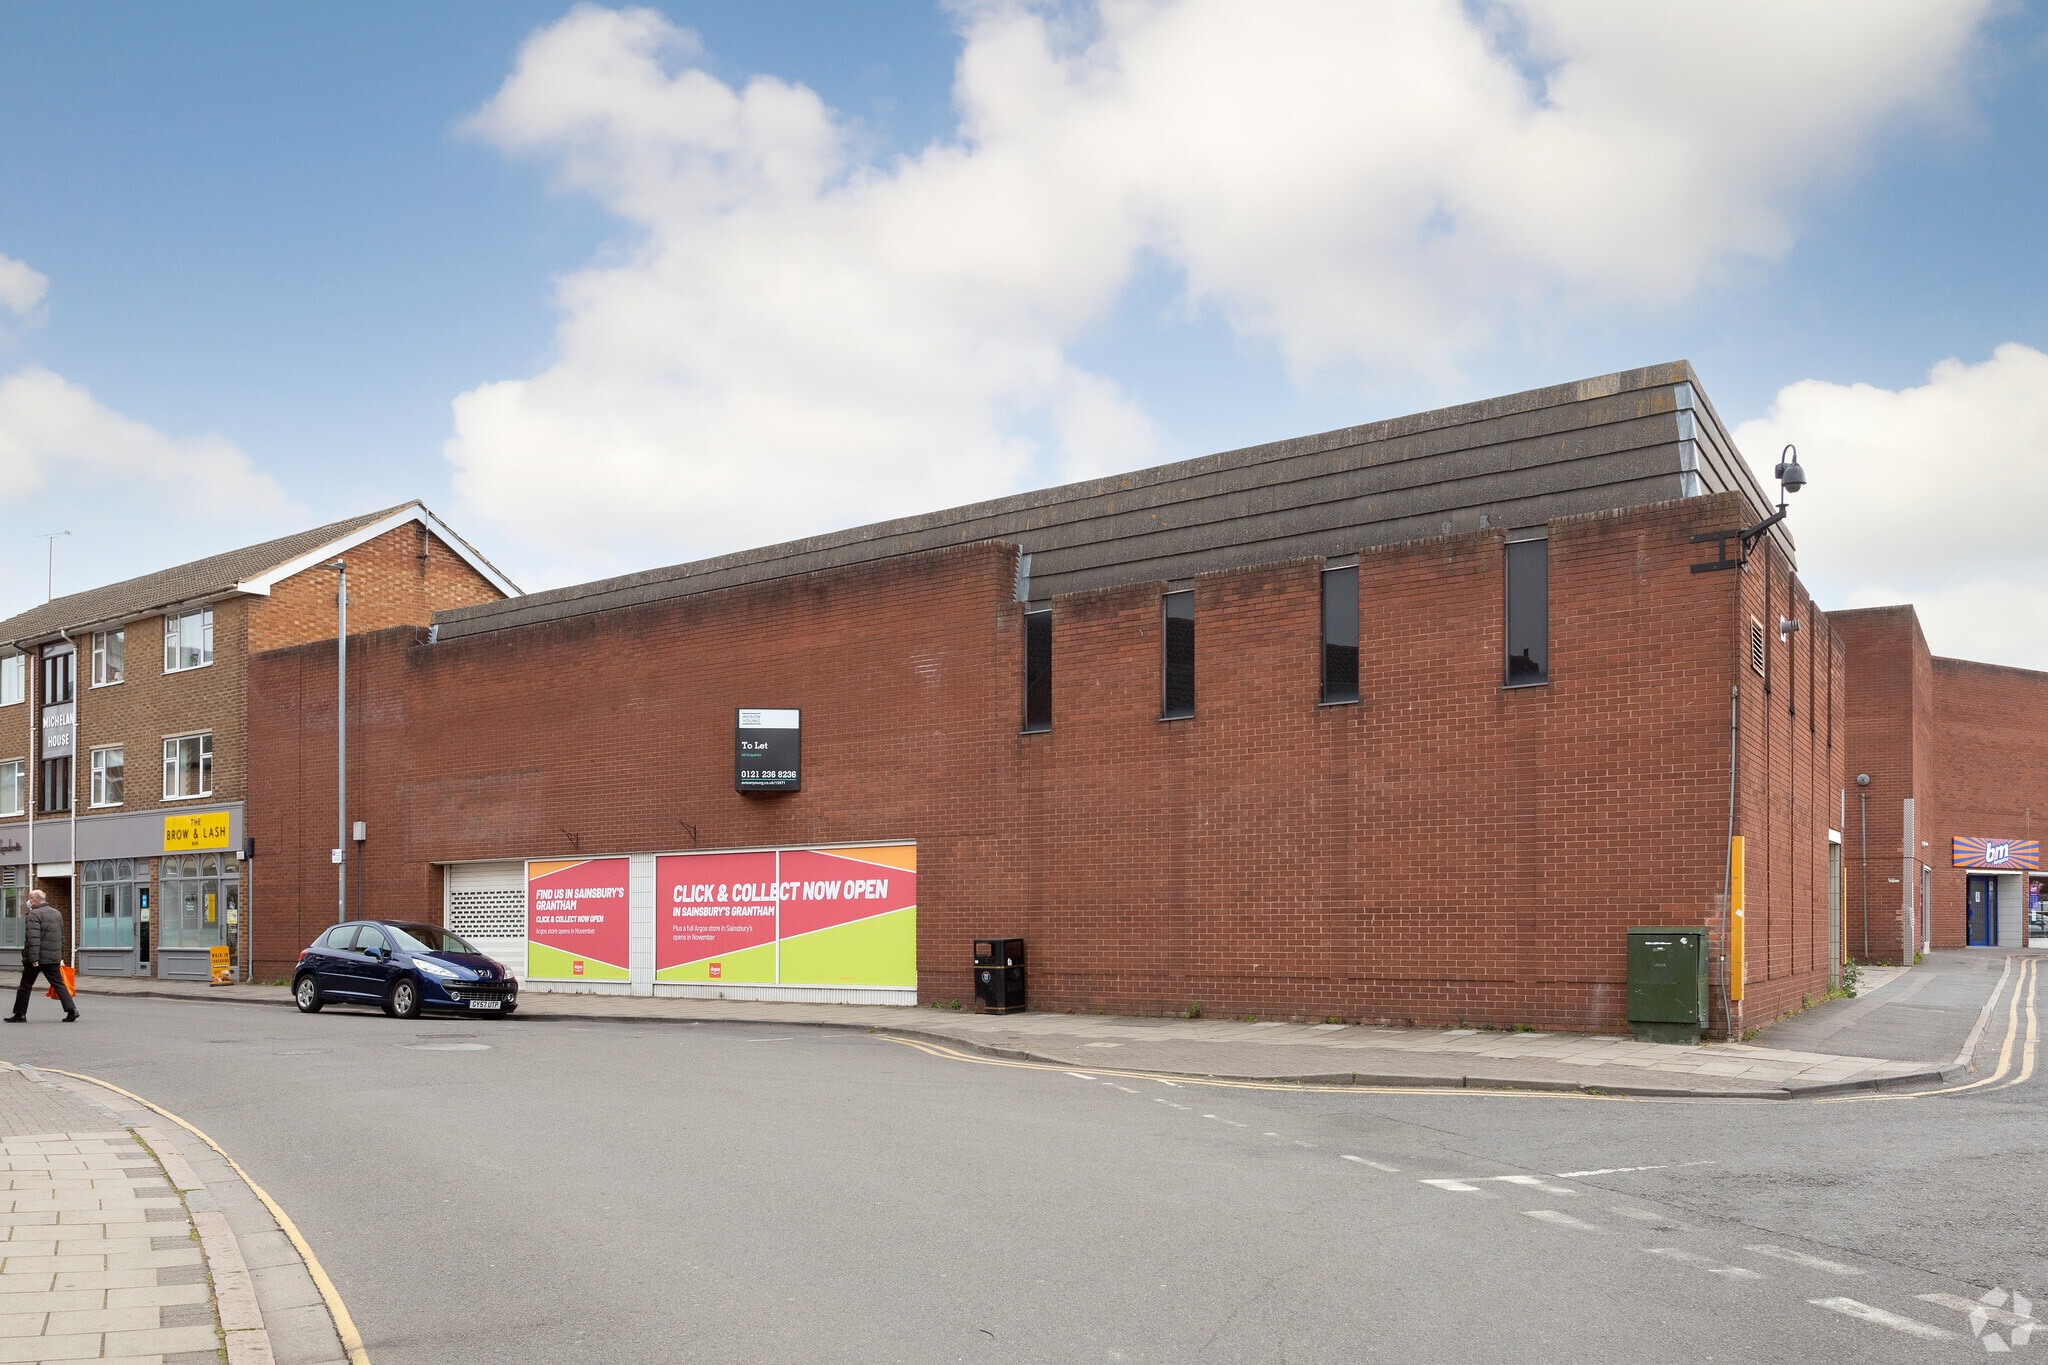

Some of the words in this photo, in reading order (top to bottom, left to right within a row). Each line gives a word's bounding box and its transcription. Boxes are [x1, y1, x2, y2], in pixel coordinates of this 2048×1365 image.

[48, 733, 70, 748] HOUSE
[741, 741, 753, 750] To
[754, 741, 768, 750] Let
[741, 770, 759, 778] 0121
[762, 770, 776, 778] 236
[777, 770, 797, 778] 8236
[190, 818, 201, 826] THE
[166, 829, 189, 841] BROW
[193, 828, 198, 839] &
[203, 826, 226, 838] LASH
[536, 889, 553, 900] FIND
[554, 888, 564, 899] US
[564, 888, 574, 899] IN
[574, 887, 625, 898] SAINSBURY'S
[673, 884, 715, 903] CLICK
[716, 883, 728, 902] &
[732, 880, 800, 902] COLLECT
[802, 880, 842, 900] NOW
[843, 878, 888, 900] OPEN
[536, 900, 577, 910] GRANTHAM
[672, 906, 680, 916] IN
[682, 906, 730, 916] SAINSBURY'S
[731, 906, 775, 916] GRANTHAM
[590, 914, 604, 922] OPEN
[694, 924, 708, 933] Argos
[726, 924, 753, 933] Sainsbury's
